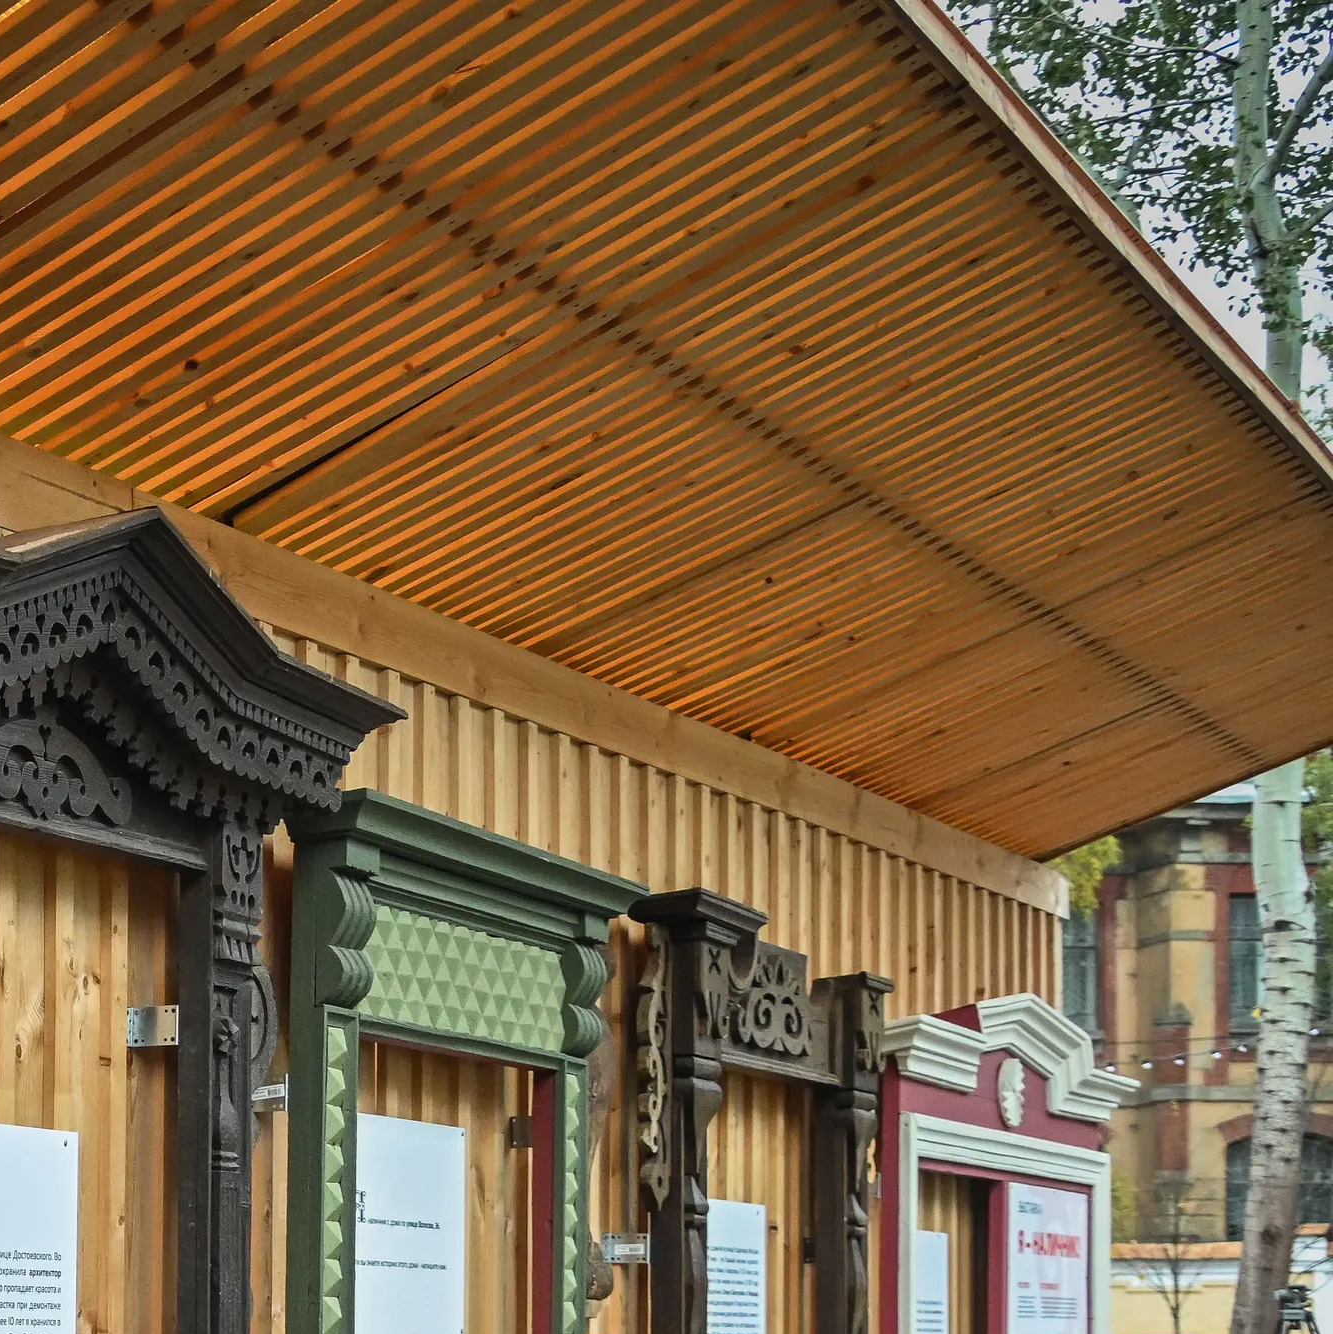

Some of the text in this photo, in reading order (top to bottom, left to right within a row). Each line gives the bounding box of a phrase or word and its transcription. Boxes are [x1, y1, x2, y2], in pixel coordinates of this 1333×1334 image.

[54, 1252, 61, 1261] Во
[29, 1269, 61, 1279] архитектор
[4, 1285, 34, 1294] пропадает
[35, 1286, 56, 1294] красота
[17, 1302, 27, 1310] при
[29, 1303, 61, 1311] демонтаже
[31, 1319, 56, 1328] хранился
